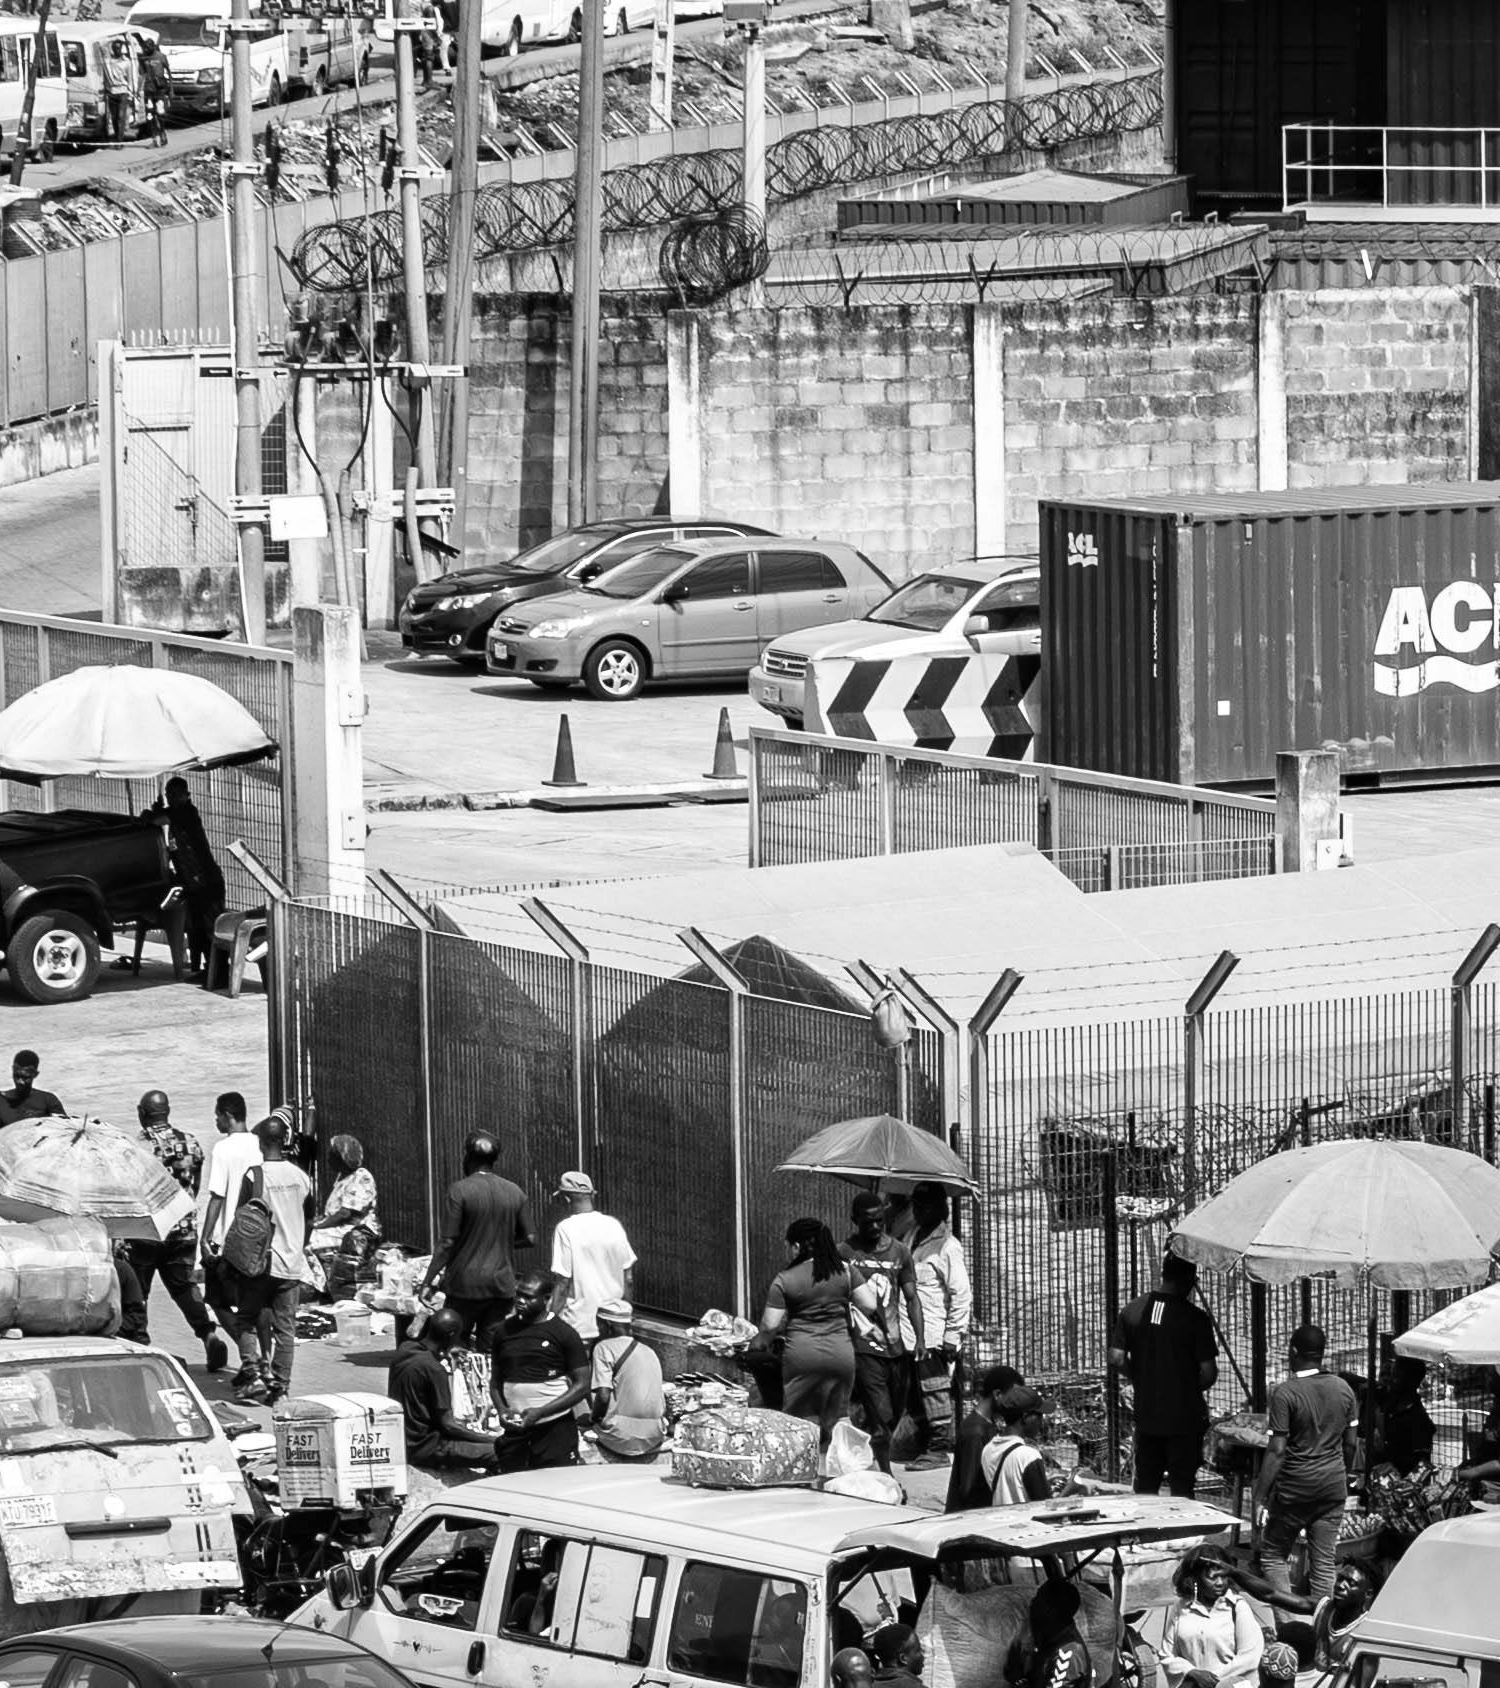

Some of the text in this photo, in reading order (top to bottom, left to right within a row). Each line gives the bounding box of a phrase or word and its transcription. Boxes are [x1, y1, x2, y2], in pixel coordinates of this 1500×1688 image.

[286, 1433, 381, 1446] FAST FAST
[285, 1448, 320, 1461] Delivery
